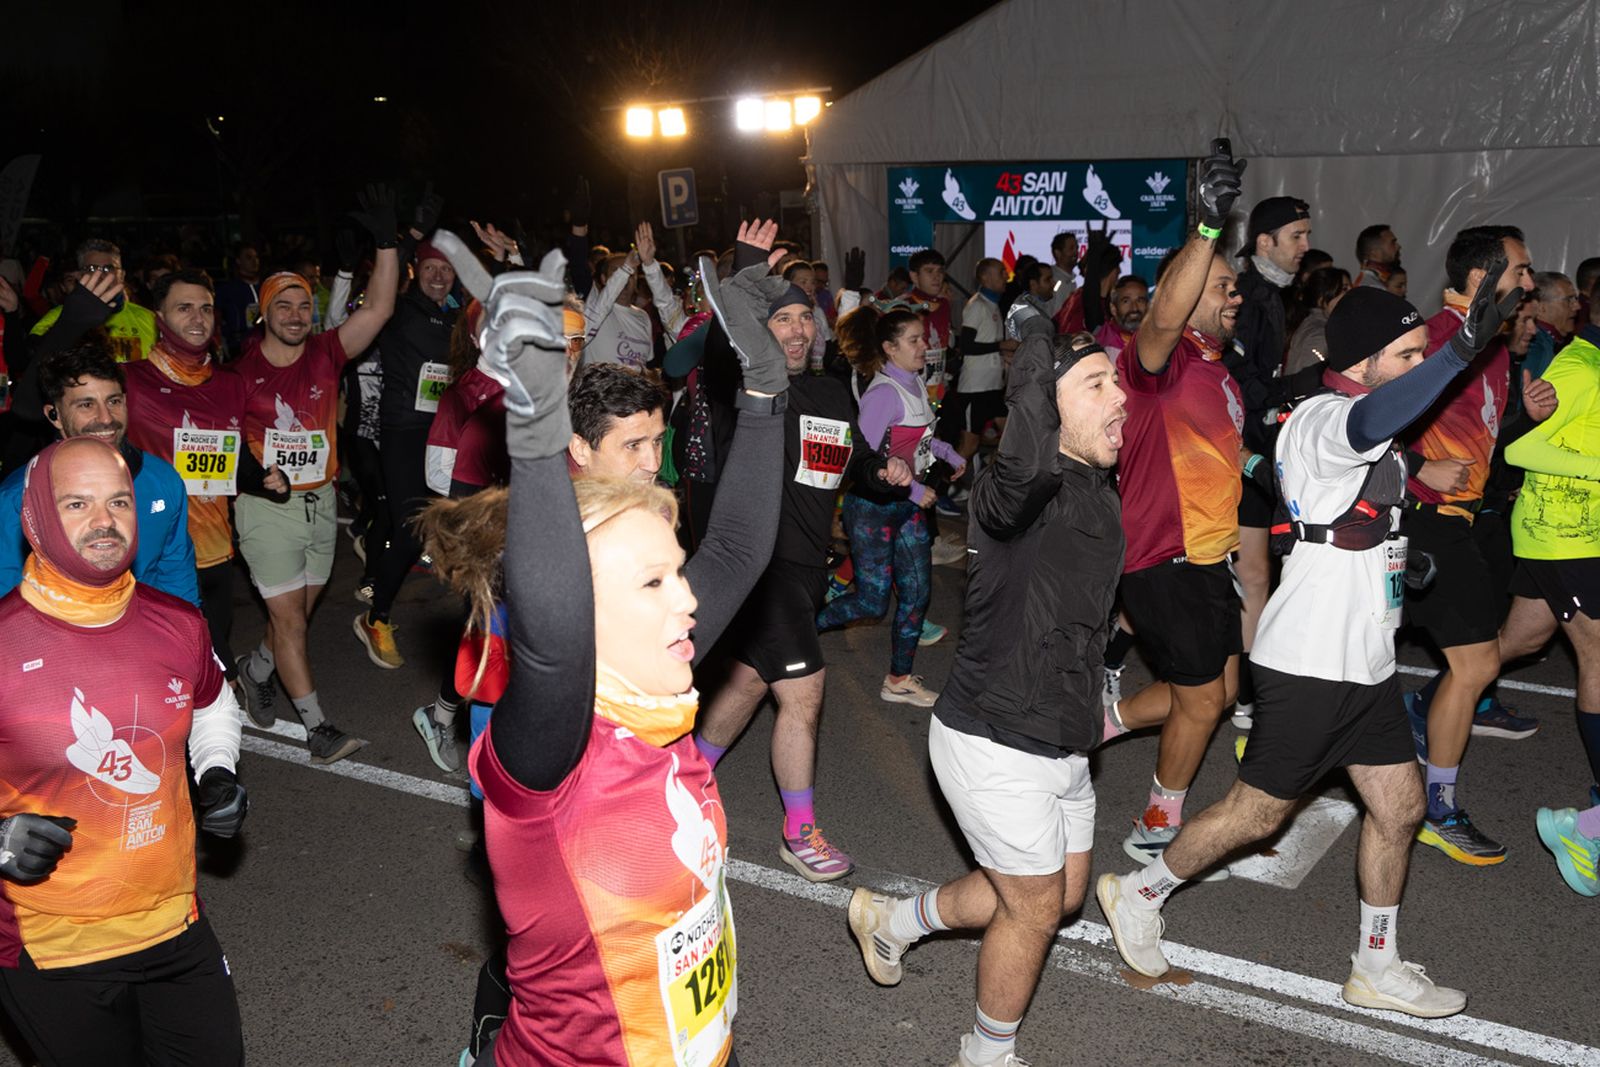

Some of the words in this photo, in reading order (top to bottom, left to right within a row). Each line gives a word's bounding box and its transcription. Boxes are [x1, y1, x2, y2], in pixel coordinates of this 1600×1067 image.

[667, 176, 688, 220] P
[989, 190, 1063, 216] ANTÓN
[186, 453, 227, 473] 3978
[276, 450, 318, 467] 5494
[97, 750, 132, 782] 43
[128, 817, 153, 833] SAN
[674, 948, 699, 977] SAN
